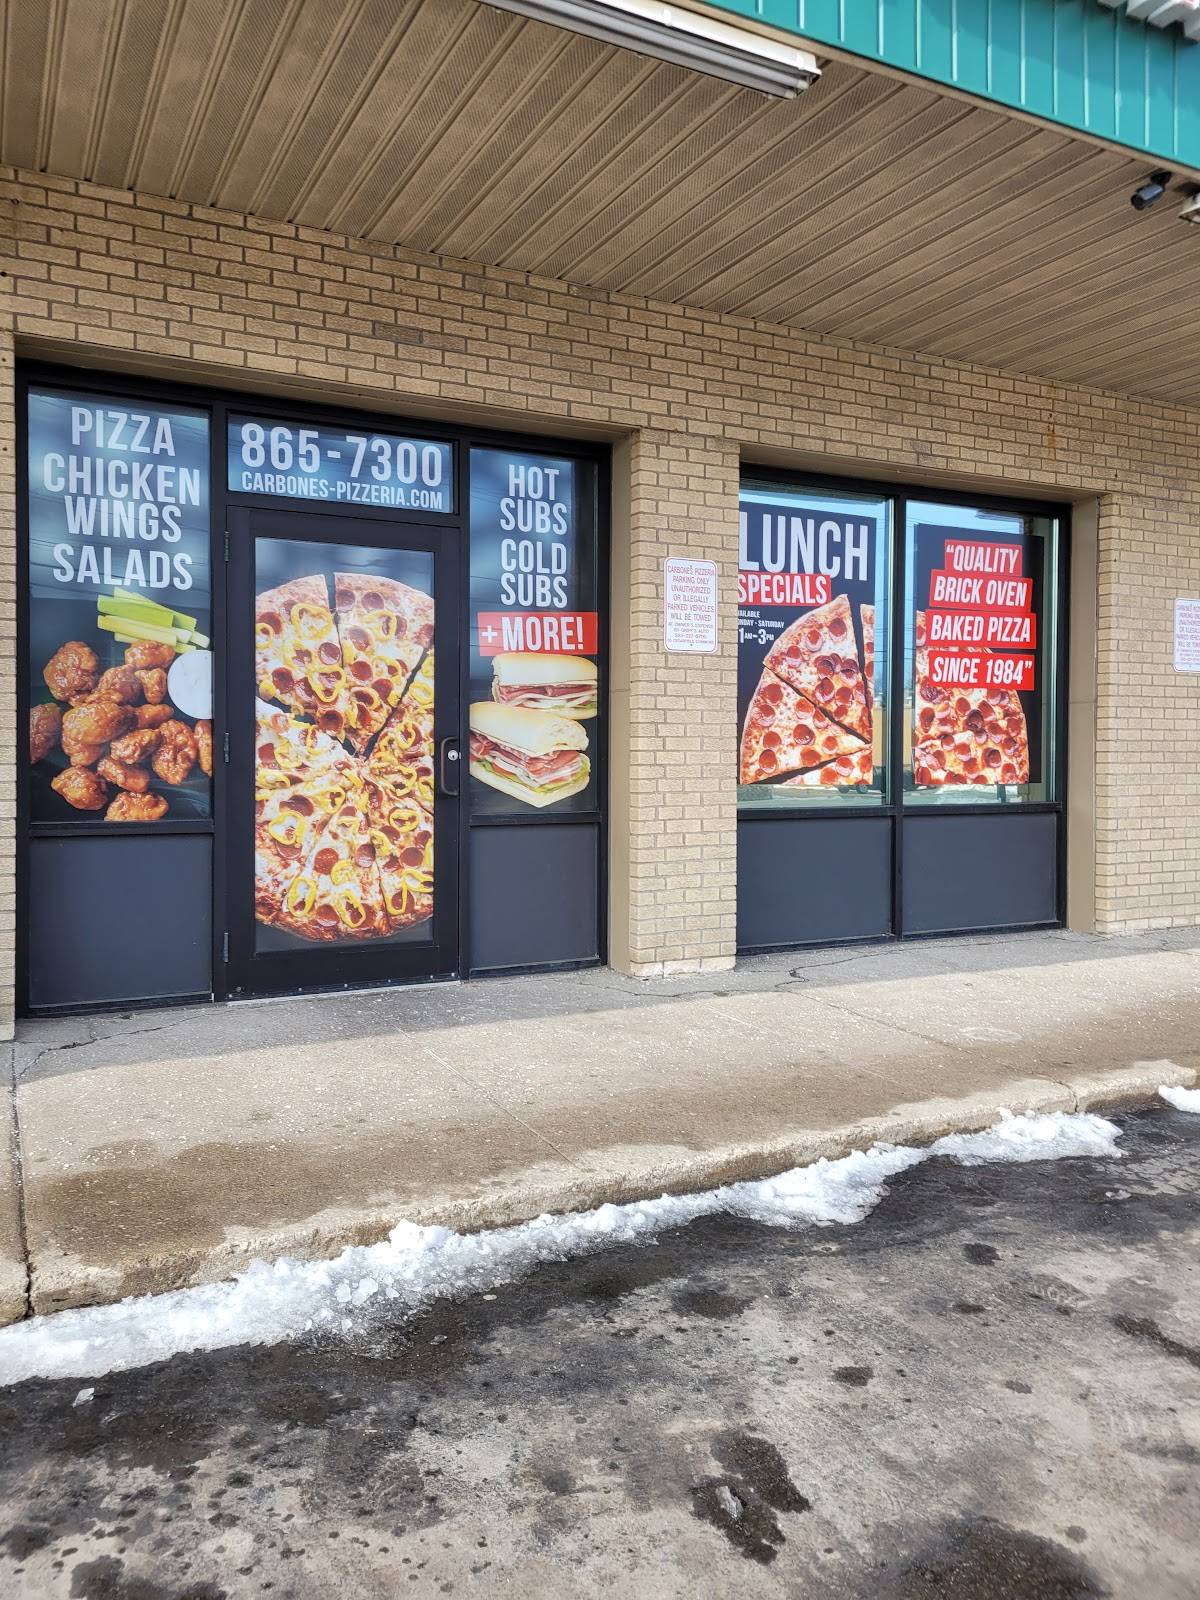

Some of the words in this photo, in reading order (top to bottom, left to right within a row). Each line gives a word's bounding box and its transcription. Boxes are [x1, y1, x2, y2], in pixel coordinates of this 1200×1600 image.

[71, 406, 176, 457] PIZZA
[240, 422, 443, 487] 865-7300
[43, 452, 201, 507] CHICKEN
[241, 470, 443, 510] CARBONES-PIZZERIA.COM
[508, 464, 560, 501] HOT
[64, 494, 183, 543] WINGS
[500, 497, 568, 536] SUBS
[501, 538, 567, 575] COLD
[738, 511, 869, 581] LUNCH
[52, 543, 193, 591] SALADS
[672, 576, 696, 584] PARKING
[500, 572, 568, 609] SUBS
[671, 585, 712, 594] UNAUTHORIZED
[682, 595, 709, 603] ILLEGALLY
[738, 574, 828, 604] SPECIALS
[933, 576, 983, 604] BRICK
[985, 580, 1027, 607] OVEN
[667, 603, 689, 611] PARKED
[690, 604, 715, 613] VEHICLES
[671, 612, 682, 620] WILL
[684, 613, 692, 621] BE
[693, 614, 712, 622] TOWED
[758, 620, 785, 628] SATURDAY
[930, 615, 984, 641] BAKED
[987, 618, 1031, 642] PIZZA
[932, 657, 980, 683] SINCE
